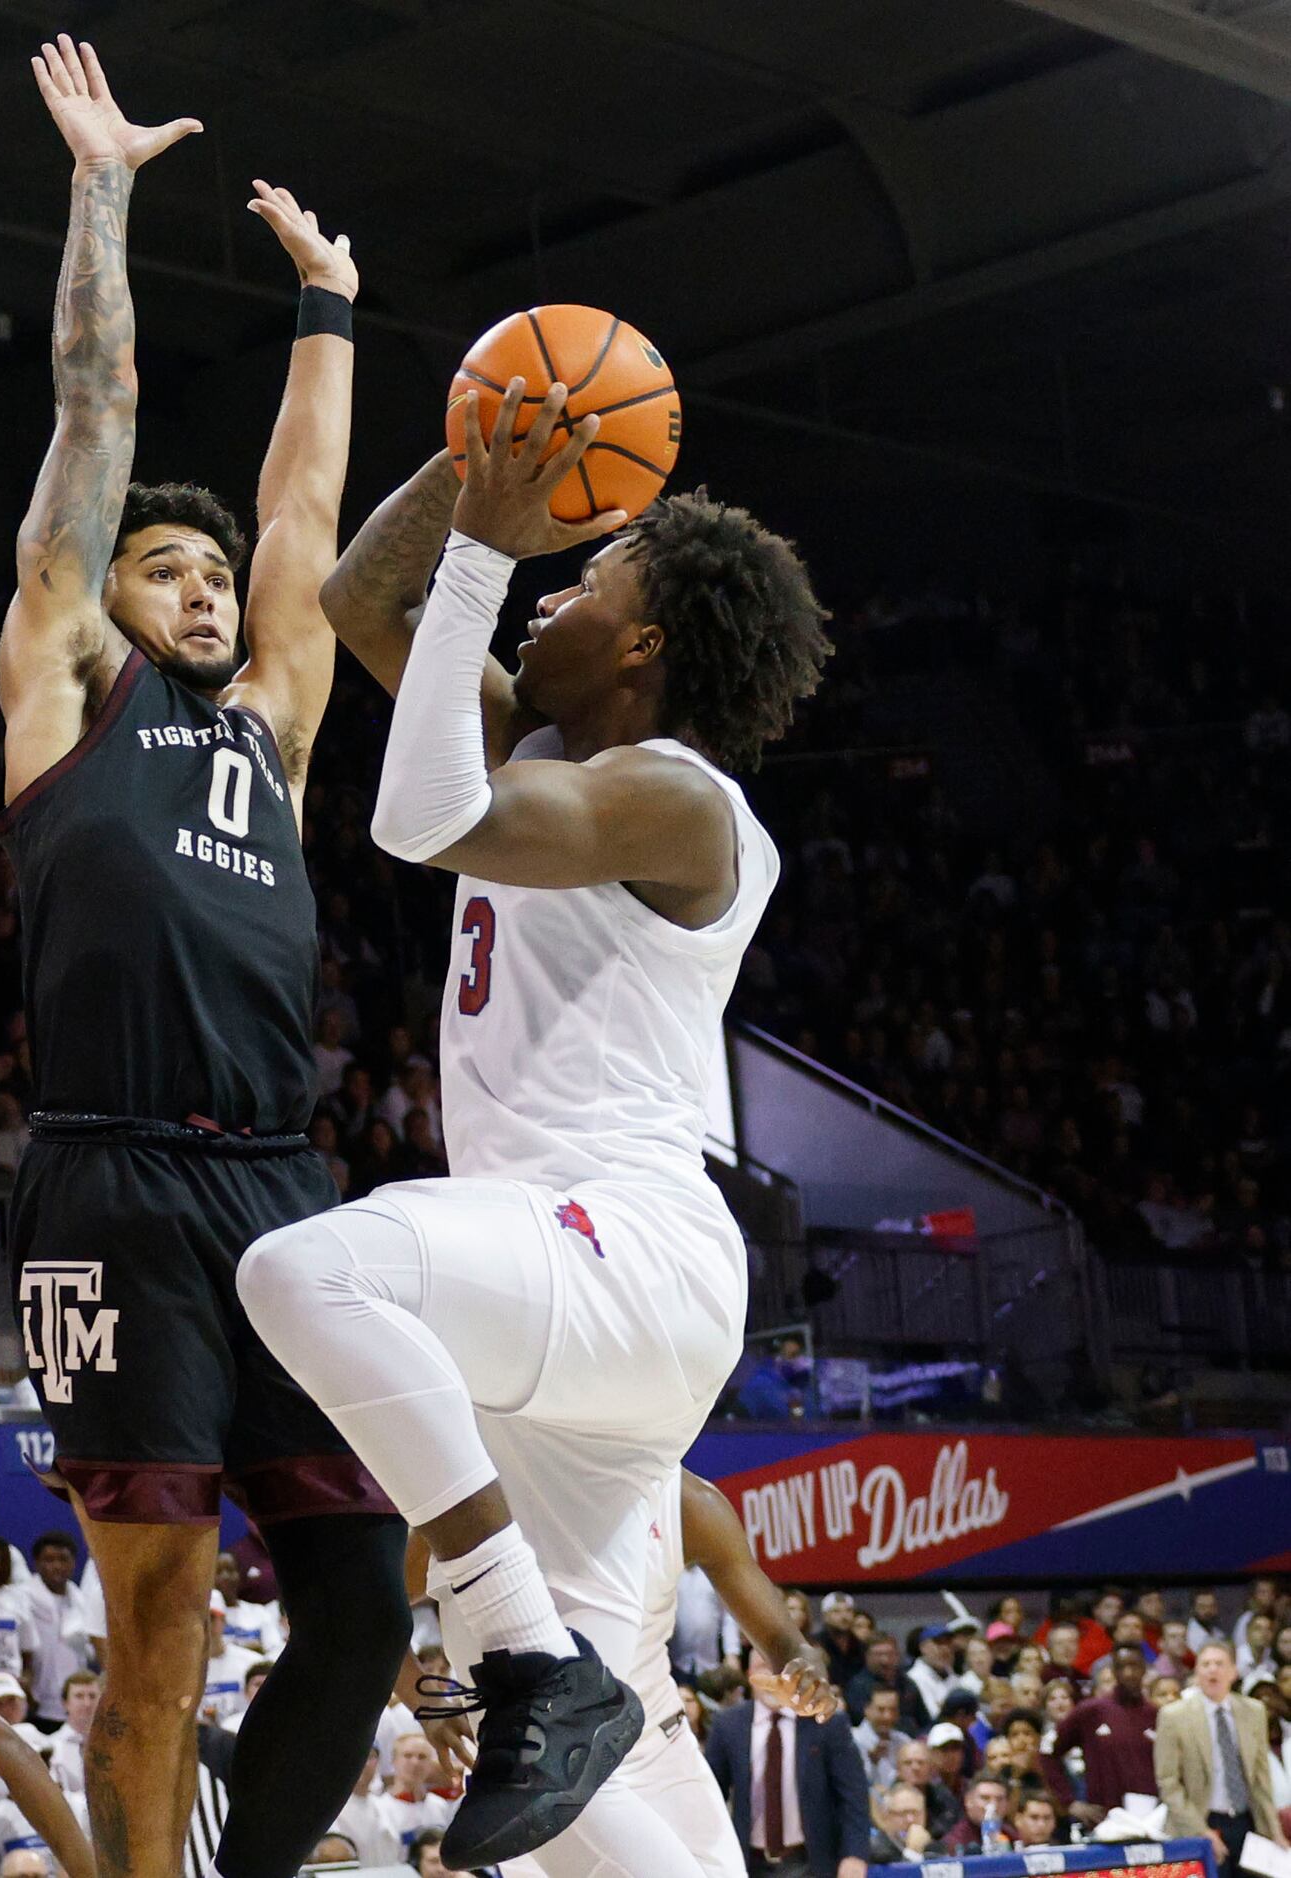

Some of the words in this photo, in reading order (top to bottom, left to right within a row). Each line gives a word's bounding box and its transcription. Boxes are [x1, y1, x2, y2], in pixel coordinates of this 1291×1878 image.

[207, 747, 253, 838] 0
[175, 828, 275, 887] AGGIES
[458, 896, 496, 1017] 3
[741, 1470, 816, 1561] PONY
[819, 1458, 858, 1541] UP
[857, 1439, 1010, 1570] Dallas
